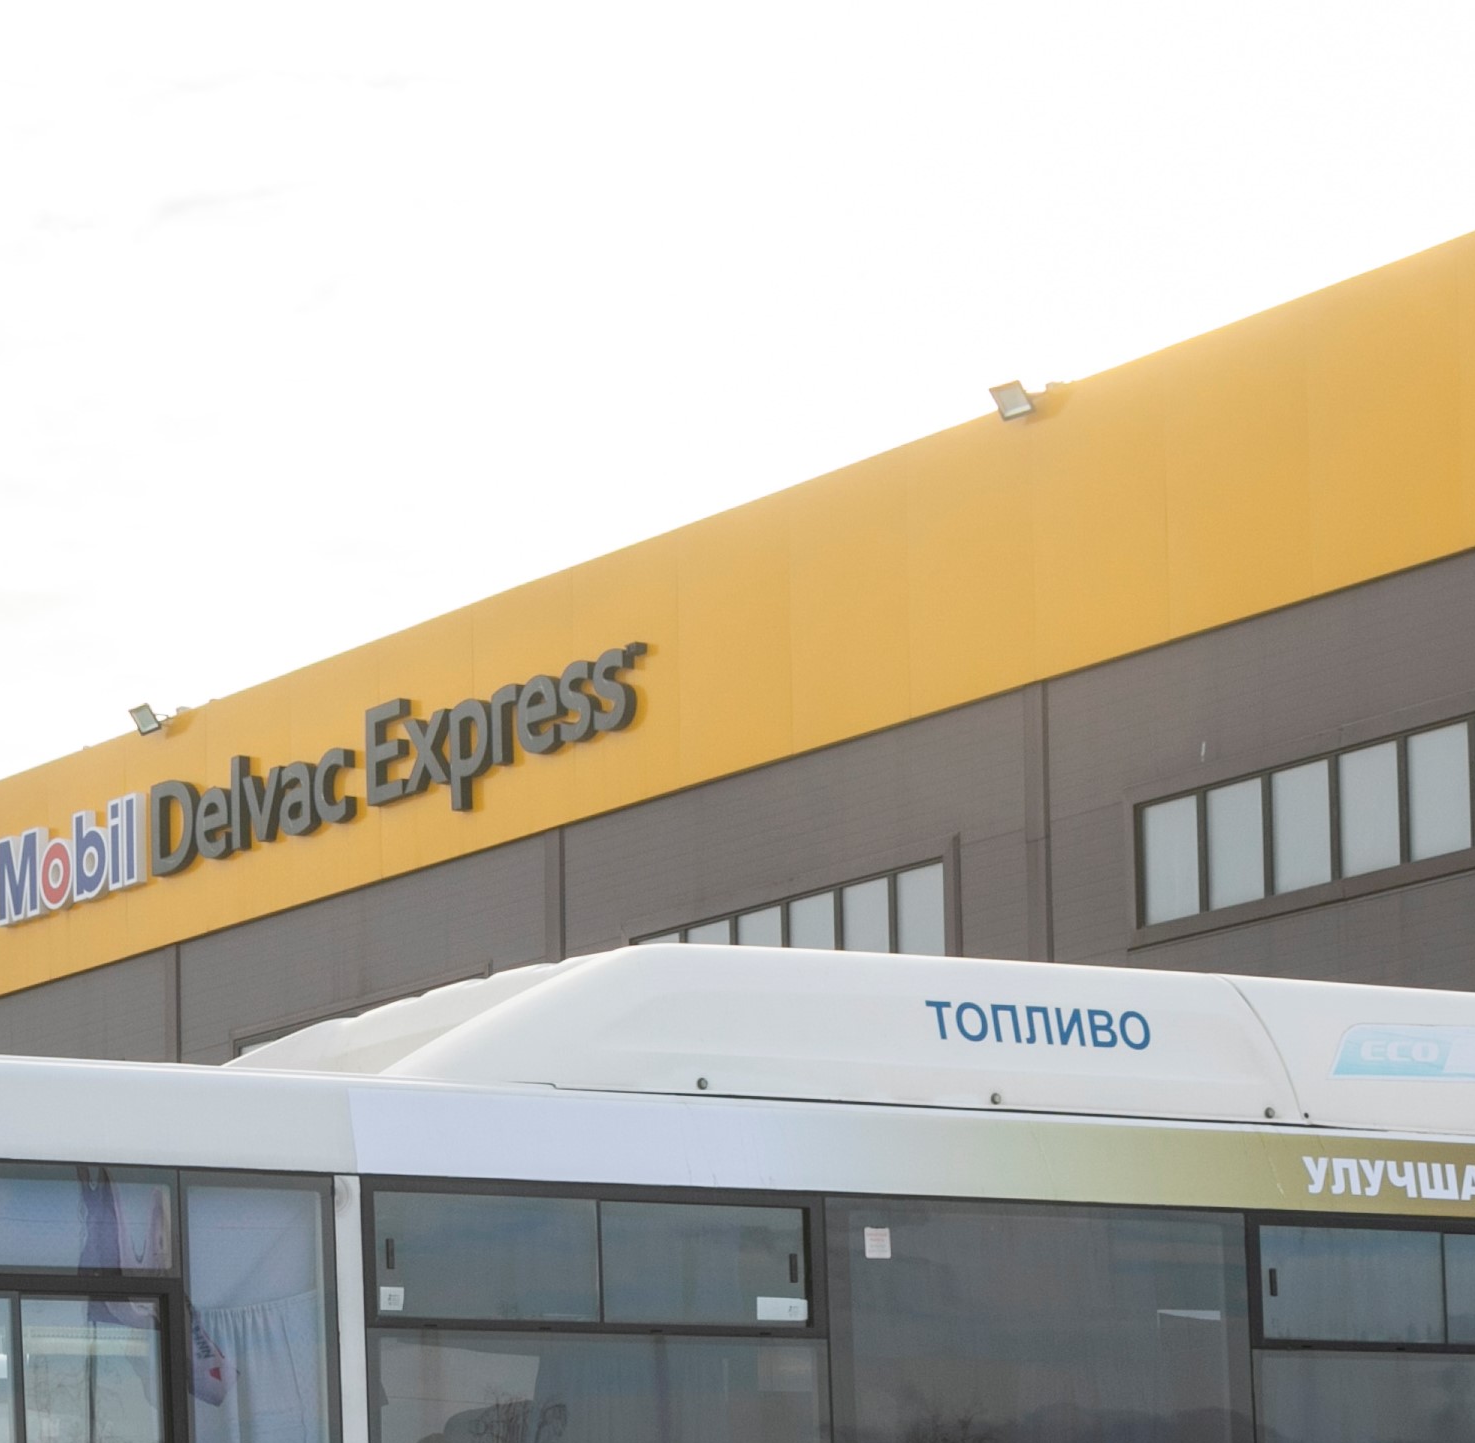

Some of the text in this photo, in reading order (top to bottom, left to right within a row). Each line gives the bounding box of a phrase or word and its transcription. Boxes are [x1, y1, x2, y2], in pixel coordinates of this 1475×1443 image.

[150, 747, 355, 876] Delvac
[365, 646, 637, 811] Express
[925, 1000, 1151, 1051] ТОПЛИВО
